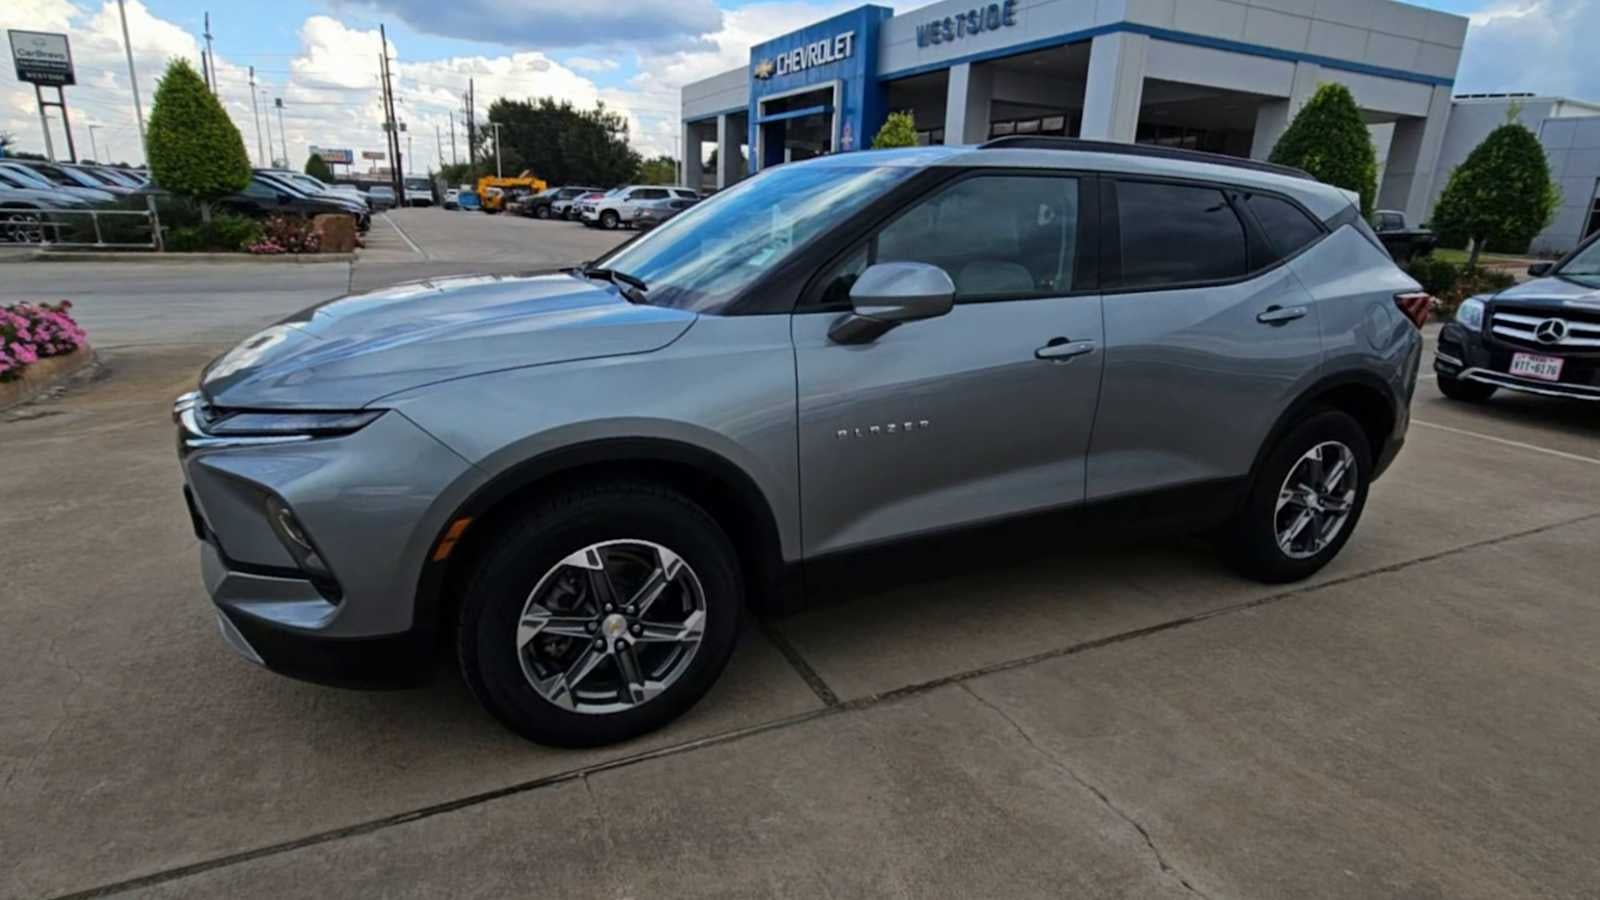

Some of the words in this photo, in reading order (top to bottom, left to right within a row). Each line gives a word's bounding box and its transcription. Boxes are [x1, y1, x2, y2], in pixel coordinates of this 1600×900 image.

[916, 0, 1017, 48] WESTSIDE
[776, 30, 855, 75] CHEVROLET
[837, 419, 929, 439] BLAZER
